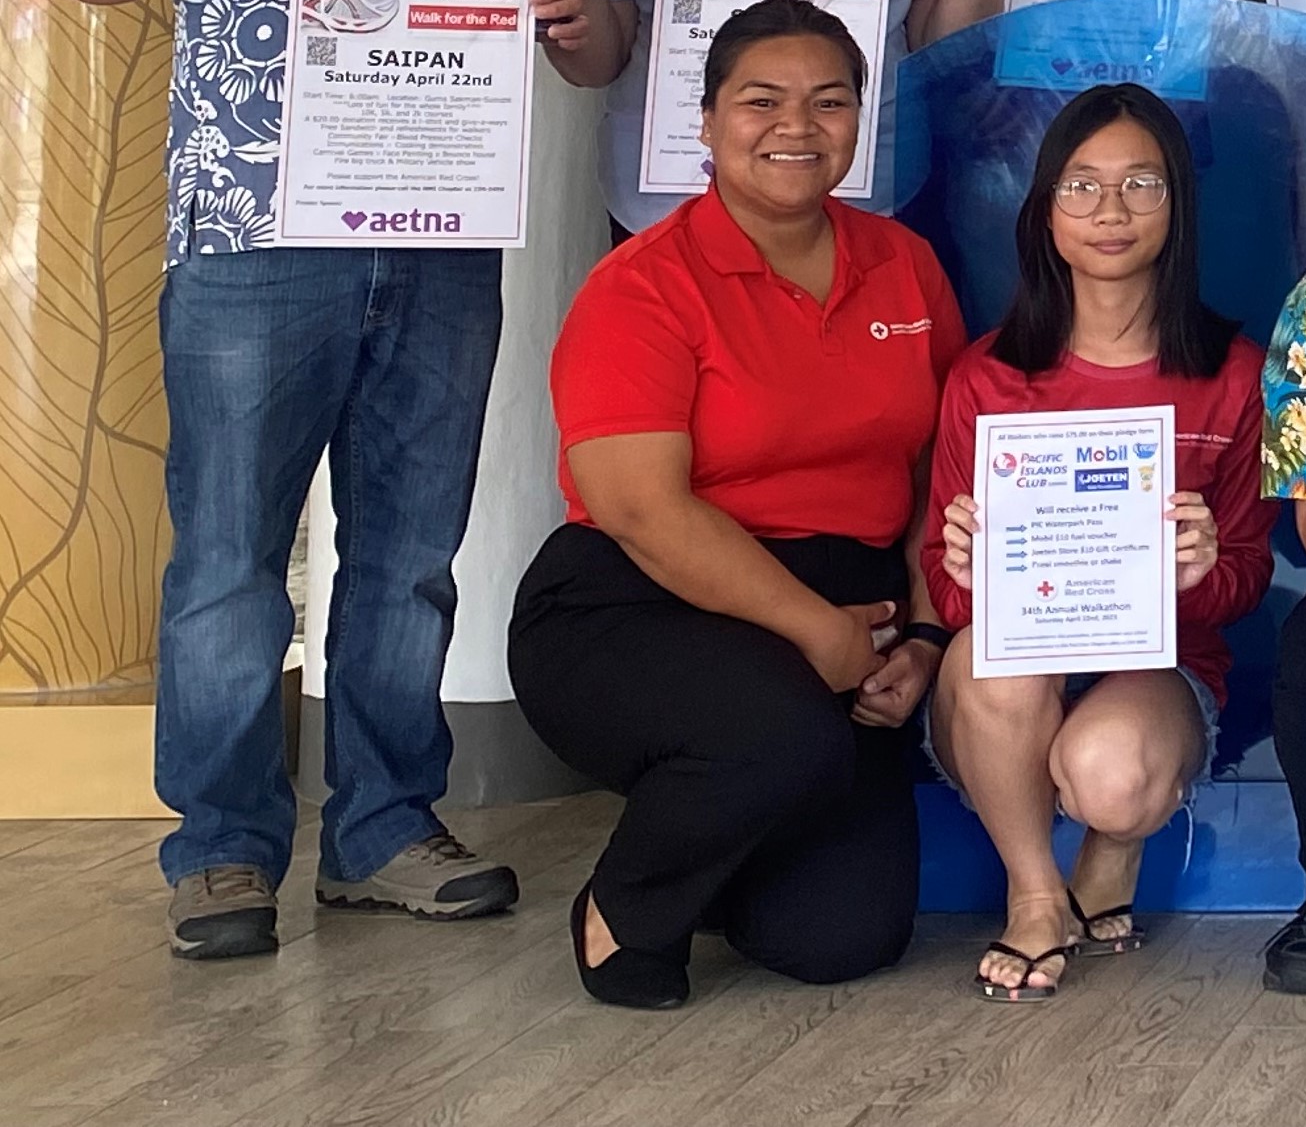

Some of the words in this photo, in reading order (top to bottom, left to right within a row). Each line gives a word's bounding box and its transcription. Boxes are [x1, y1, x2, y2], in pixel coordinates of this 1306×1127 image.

[410, 11, 442, 23] Walk
[444, 12, 464, 24] for
[465, 13, 486, 24] the
[490, 13, 516, 25] Red
[367, 49, 463, 68] SAIPAN
[324, 70, 400, 86] Saturday
[405, 72, 444, 87] April
[451, 73, 491, 86] 22nd
[369, 207, 461, 232] aetna
[1020, 451, 1062, 464] PACIFIC
[1076, 445, 1127, 463] Mobil
[1020, 464, 1067, 476] ISLANDS
[1016, 476, 1047, 488] CLUB
[1083, 472, 1127, 484] JOETEN
